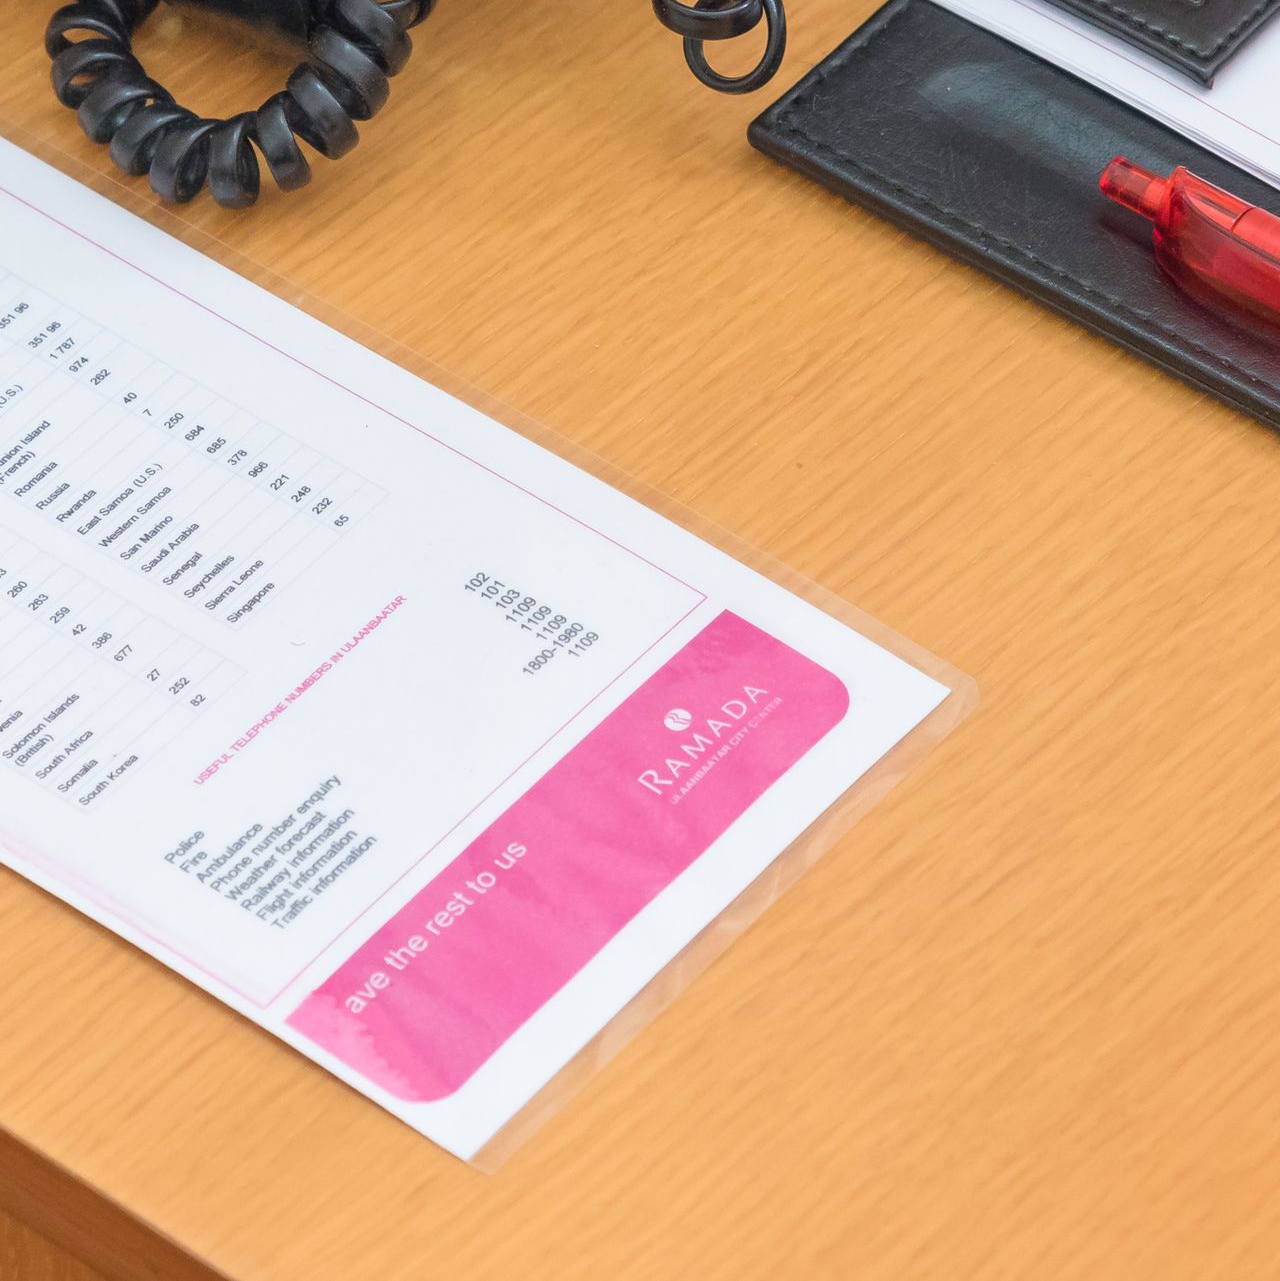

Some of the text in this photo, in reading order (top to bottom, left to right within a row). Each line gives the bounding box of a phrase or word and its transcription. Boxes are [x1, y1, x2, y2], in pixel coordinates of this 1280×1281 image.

[269, 473, 290, 490] 221
[333, 514, 349, 526] 65
[162, 551, 203, 585] Senegal
[464, 572, 490, 591] 102
[27, 593, 49, 611] 263
[226, 582, 275, 623] Singapore
[481, 580, 505, 599] 101
[495, 589, 521, 608] 103
[505, 596, 537, 622] 1109
[520, 605, 552, 631] 1109
[536, 614, 567, 639] 1109
[567, 631, 599, 656] 1109
[522, 622, 584, 674] 1800-1980
[168, 676, 190, 694] 252
[193, 594, 407, 784] USEFUL TELEPHONE NUMBERS IN ULAANBAATAR
[728, 726, 749, 746] CITY
[747, 696, 784, 728] CNTER
[637, 685, 768, 794] RAMADA
[57, 759, 98, 792] Somalia
[164, 830, 205, 864] Police
[208, 774, 341, 892] Phone number enquiry
[179, 851, 208, 873] Fire
[195, 823, 263, 883] Ambulance
[224, 810, 327, 900] Weather forecast
[239, 808, 355, 910] Railway information
[255, 830, 358, 920] Flight information
[270, 836, 377, 928] Traffic information
[384, 934, 429, 970] the
[425, 891, 474, 935] rest
[465, 871, 496, 894] to
[493, 841, 527, 869] us
